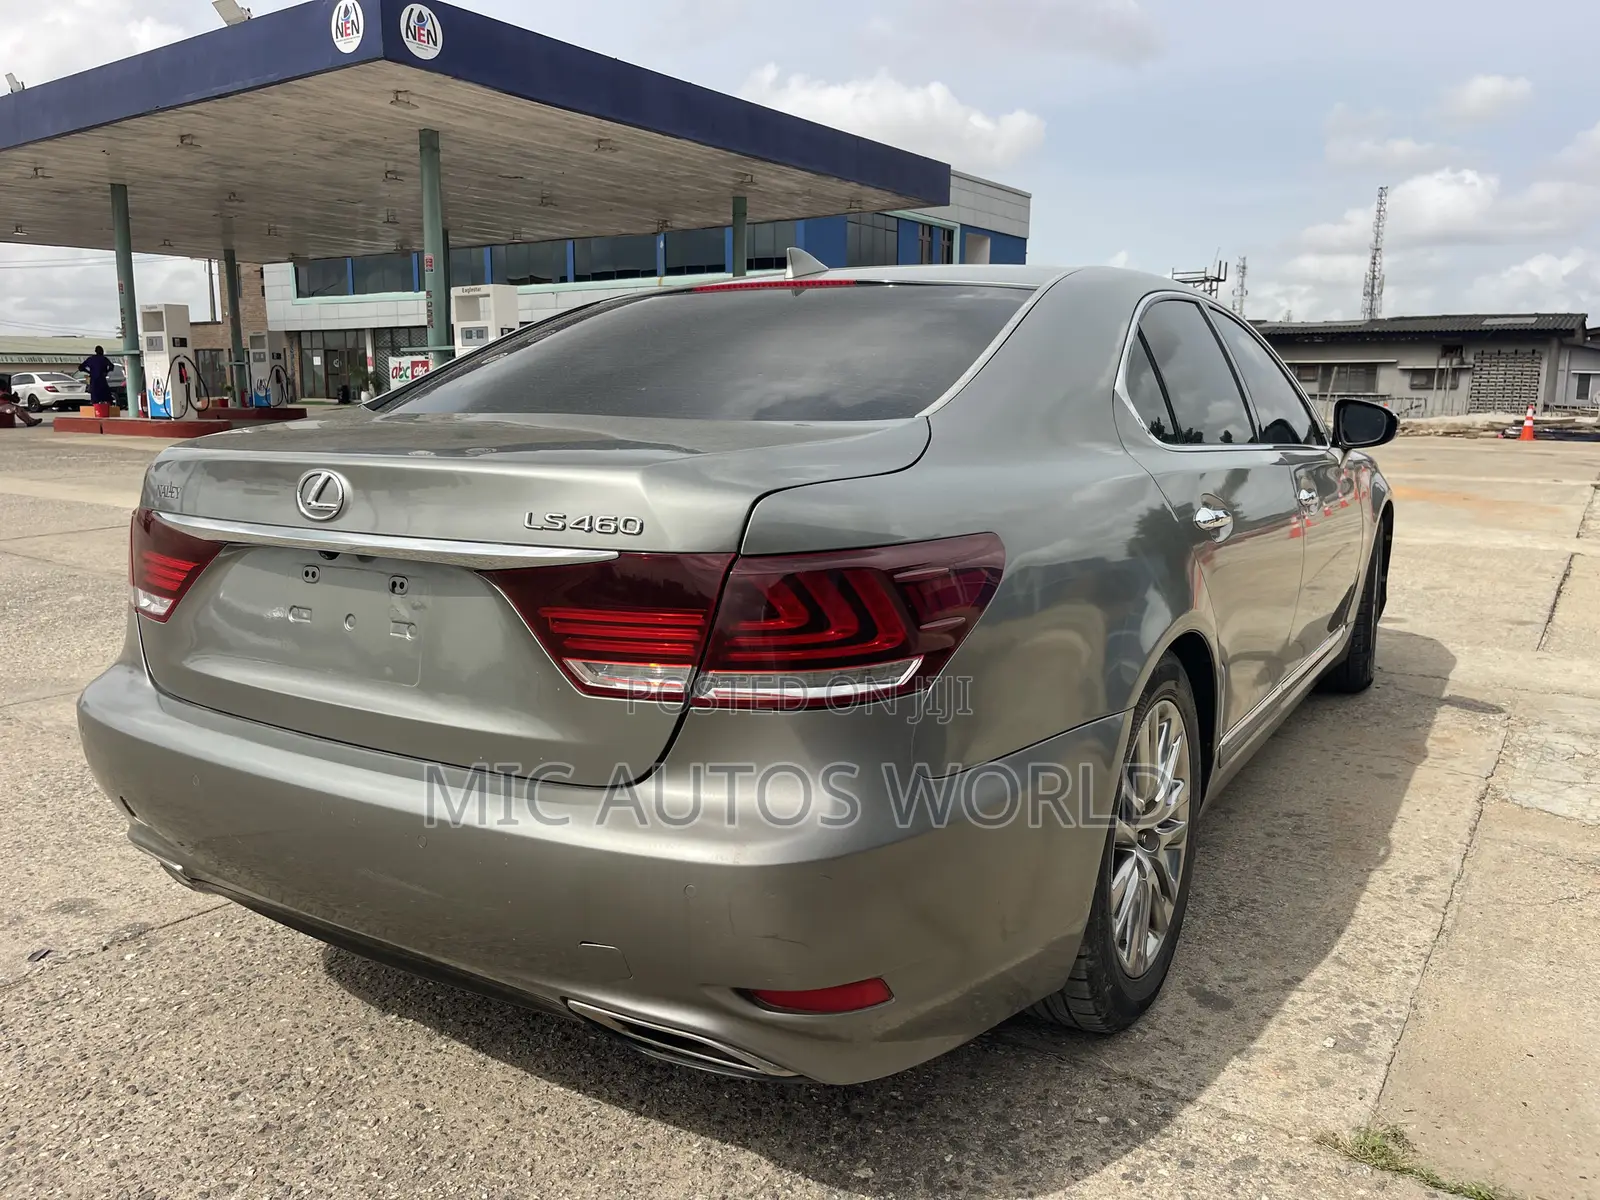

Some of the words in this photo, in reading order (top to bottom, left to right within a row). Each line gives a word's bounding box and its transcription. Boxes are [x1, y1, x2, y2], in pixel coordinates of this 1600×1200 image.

[336, 3, 360, 39] NEN
[406, 8, 438, 47] NEN
[391, 361, 411, 380] abc
[413, 363, 428, 377] abc
